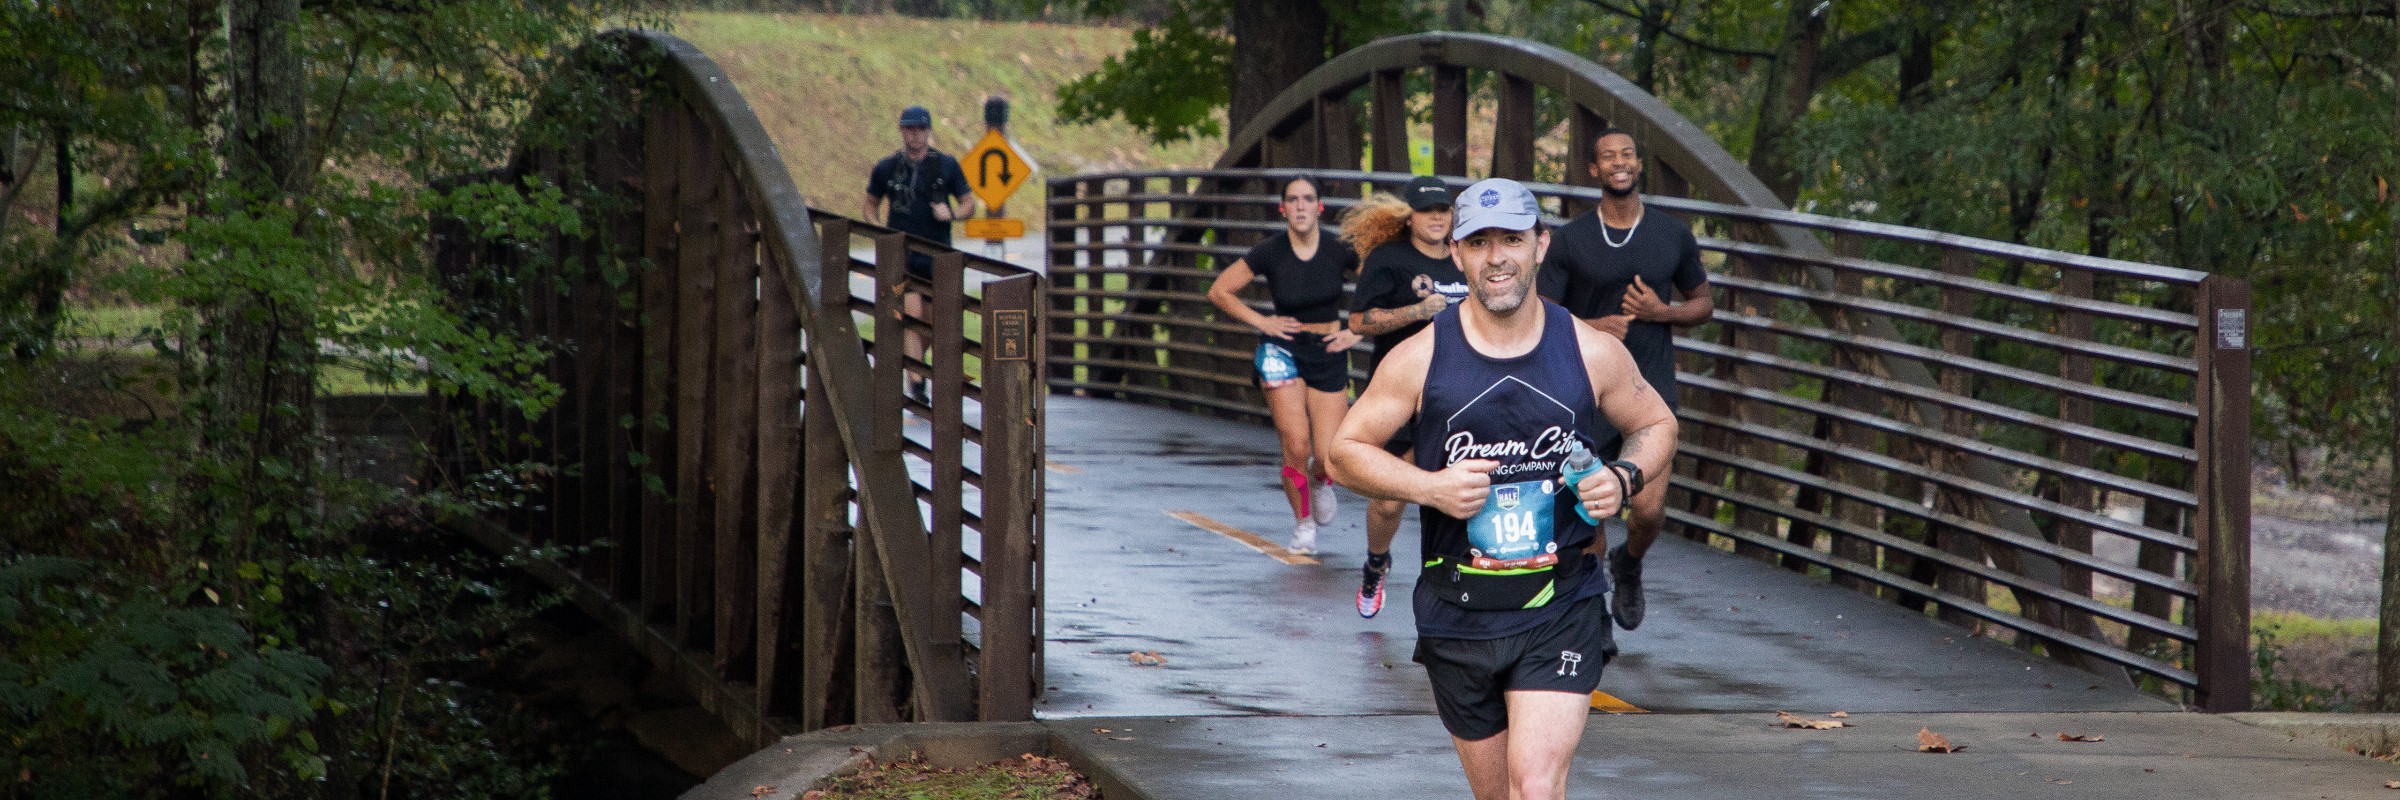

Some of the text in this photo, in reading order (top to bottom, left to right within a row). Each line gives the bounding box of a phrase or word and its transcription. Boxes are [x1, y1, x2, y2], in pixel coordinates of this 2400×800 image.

[1445, 431, 1528, 467] Dream
[1509, 461, 1556, 475] COMPANY
[1498, 492, 1518, 502] HALF
[1491, 510, 1537, 544] 194
